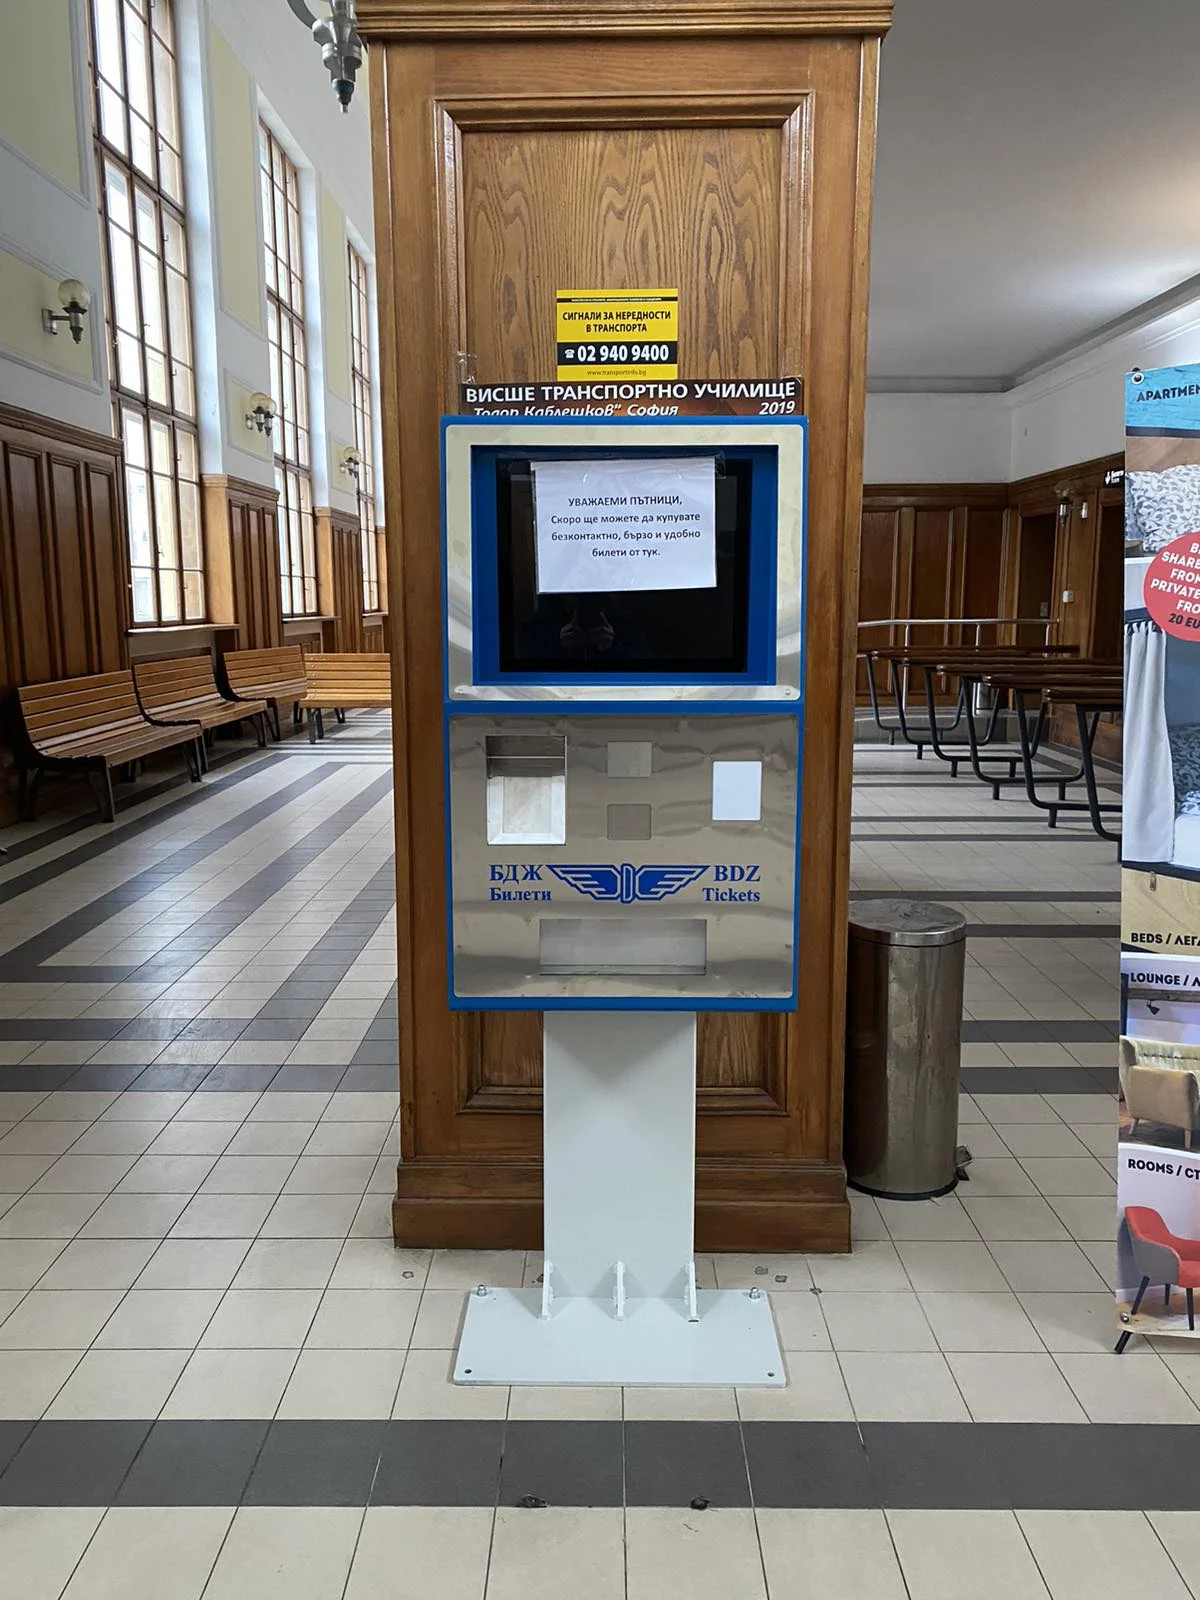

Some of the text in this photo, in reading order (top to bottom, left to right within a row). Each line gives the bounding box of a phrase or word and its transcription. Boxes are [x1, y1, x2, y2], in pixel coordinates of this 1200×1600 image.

[562, 311, 671, 321] СИГНАЛИ ЗА НЕРЕДНОСТИ
[586, 323, 647, 333] В ТРАНСПОРТА
[577, 344, 669, 362] 02 940 9400
[466, 381, 795, 403] ВИСШЕ ТРАНСПОРТНО УЧИЛИЩЕ
[627, 403, 679, 416] София
[758, 400, 795, 415] 2019
[568, 495, 683, 507] УВАЖАЕМИ ПЪТНИЦИ,
[551, 513, 701, 526] Скоро ще можете да купувате
[551, 529, 701, 541] безконтактно, бързо и удобно
[592, 548, 627, 557] билети
[642, 548, 661, 557] тук.
[1150, 578, 1200, 600] PRIVATE
[1168, 613, 1184, 625] 20
[489, 864, 544, 885] БДЖ
[713, 864, 761, 882] BDZ
[489, 887, 552, 901] Билети
[702, 887, 761, 902] Tickets
[1131, 932, 1163, 944] BEDS
[1130, 972, 1180, 985] LOUNGE
[1128, 1158, 1174, 1175] ROOMS
